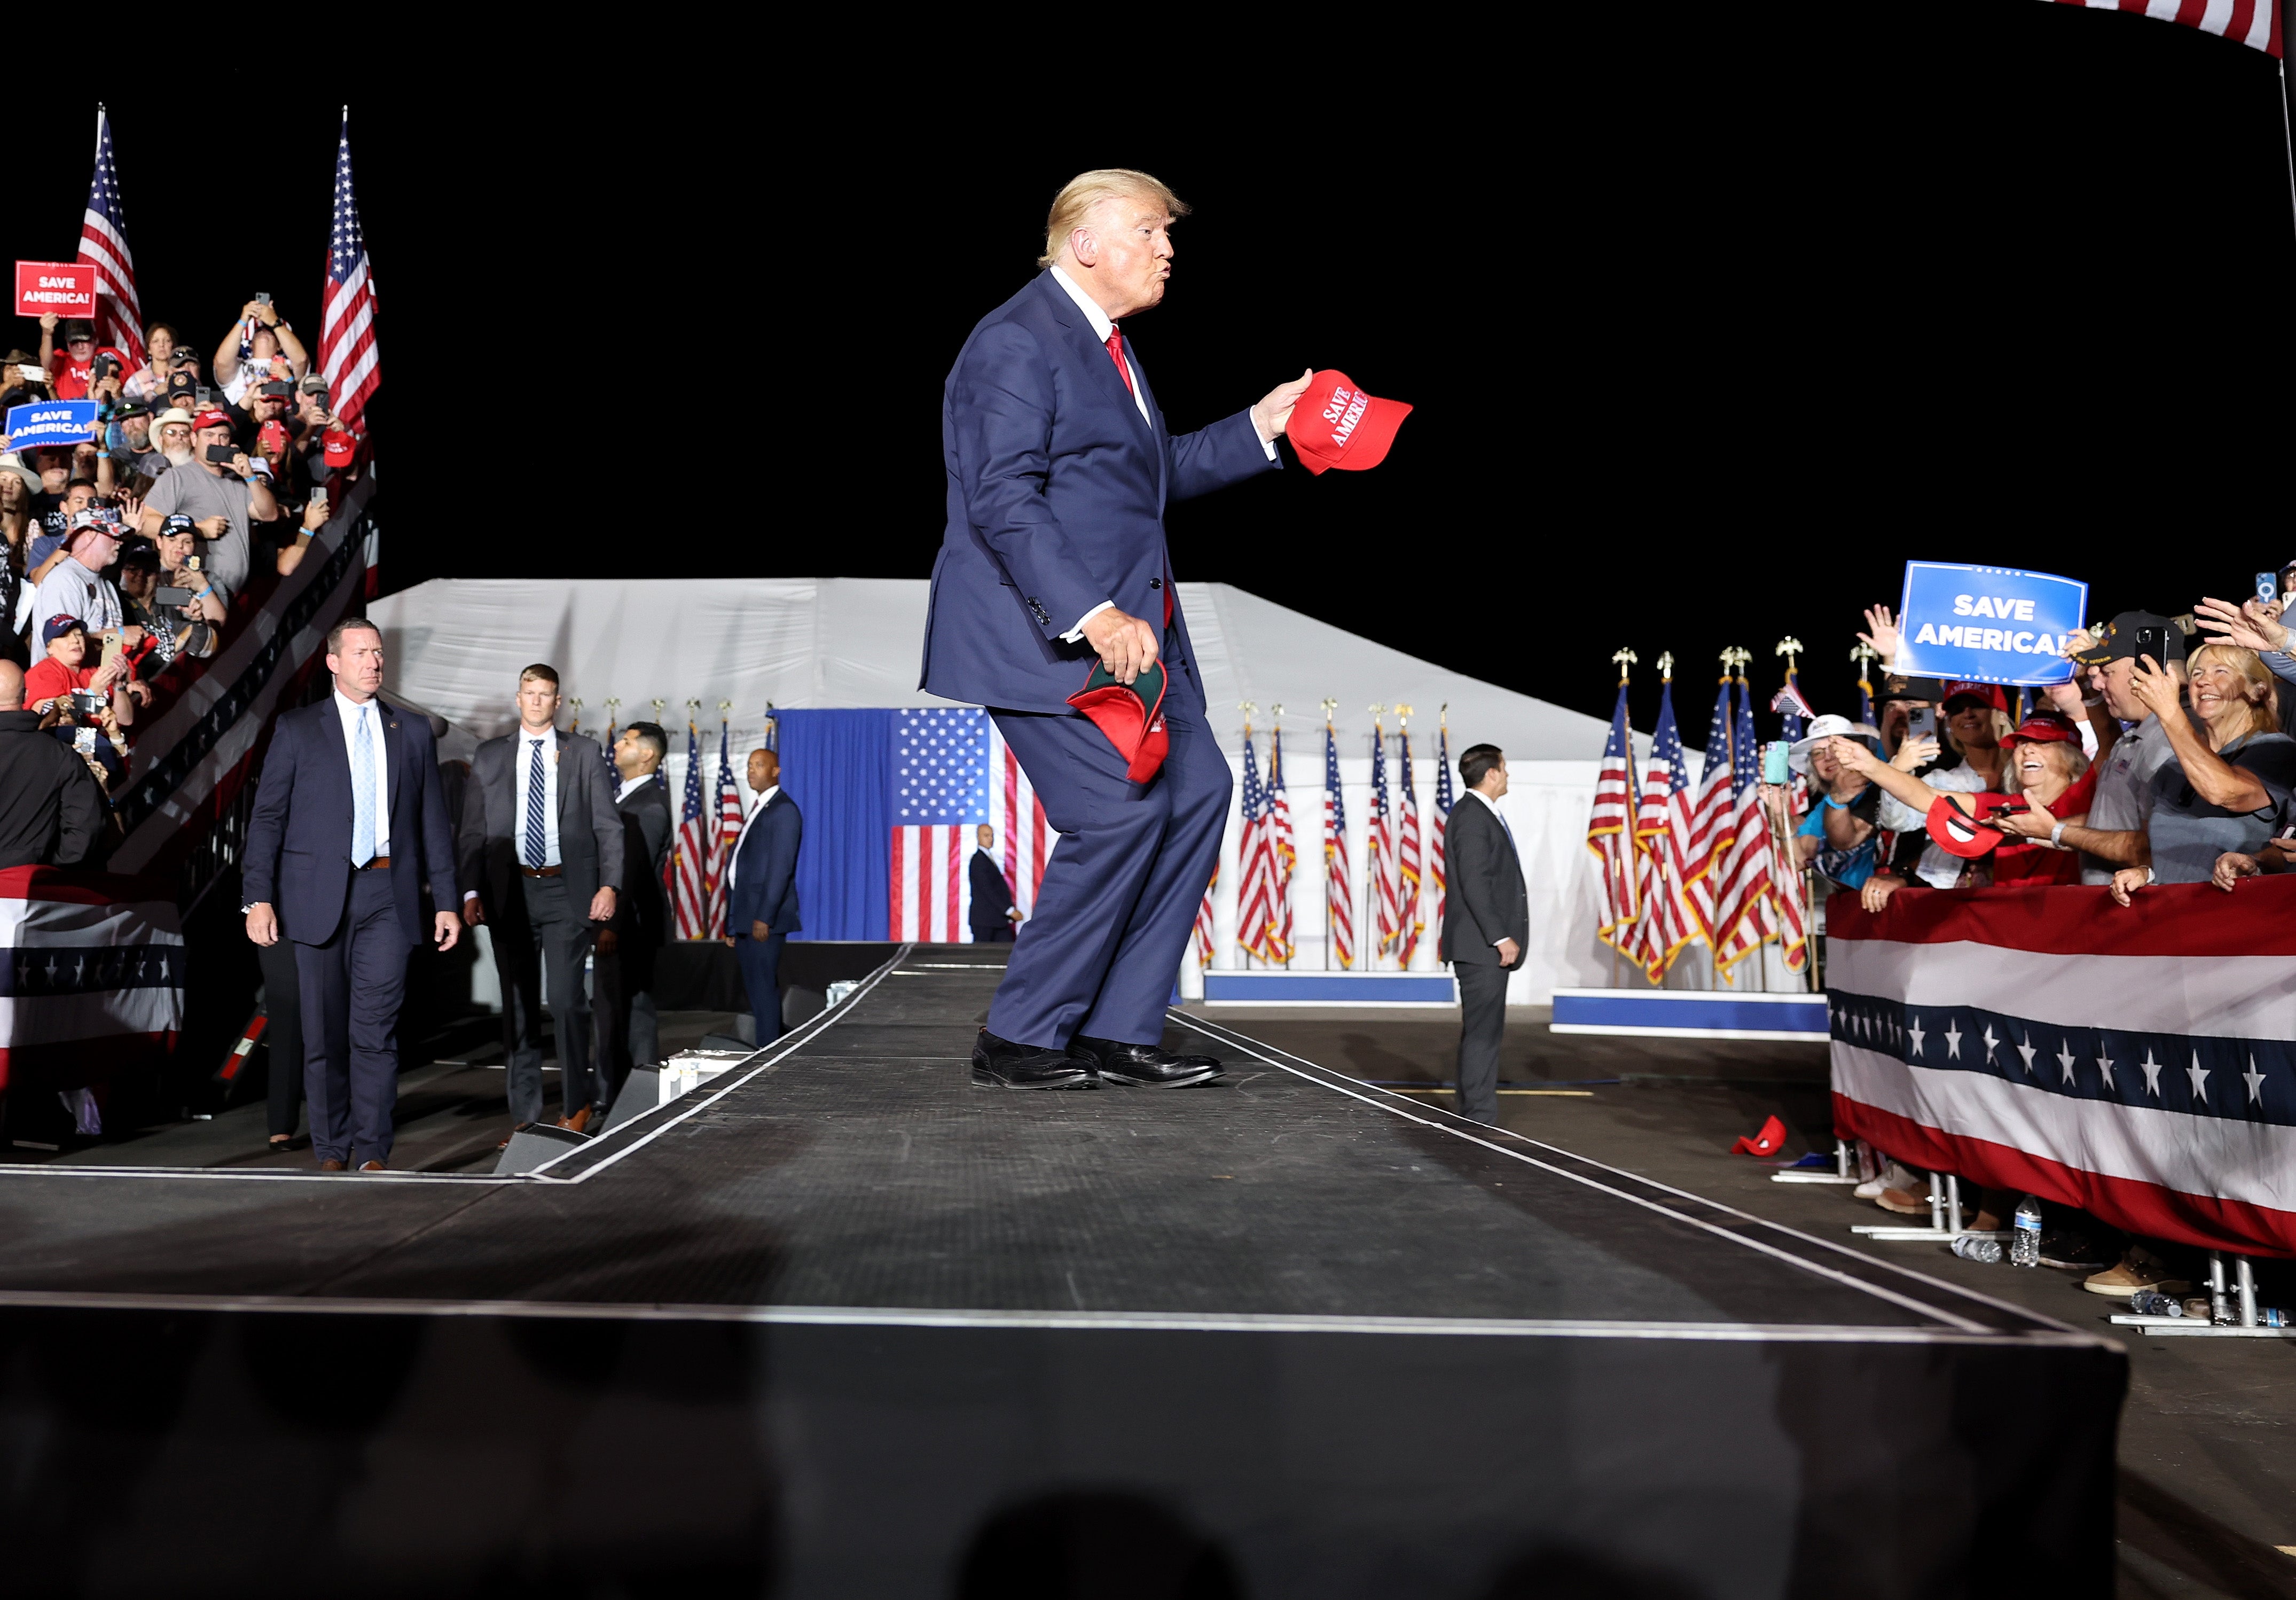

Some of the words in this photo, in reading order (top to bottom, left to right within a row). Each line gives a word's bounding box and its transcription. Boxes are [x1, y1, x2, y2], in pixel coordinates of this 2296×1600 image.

[38, 276, 76, 289] SAVE
[22, 290, 90, 304] AMERICA!
[30, 410, 73, 423] SAVE
[1322, 386, 1352, 425] SAVE
[1330, 391, 1369, 448] AMERIC
[1953, 594, 2036, 622] SAVE
[1914, 623, 2067, 657] AMERICA!
